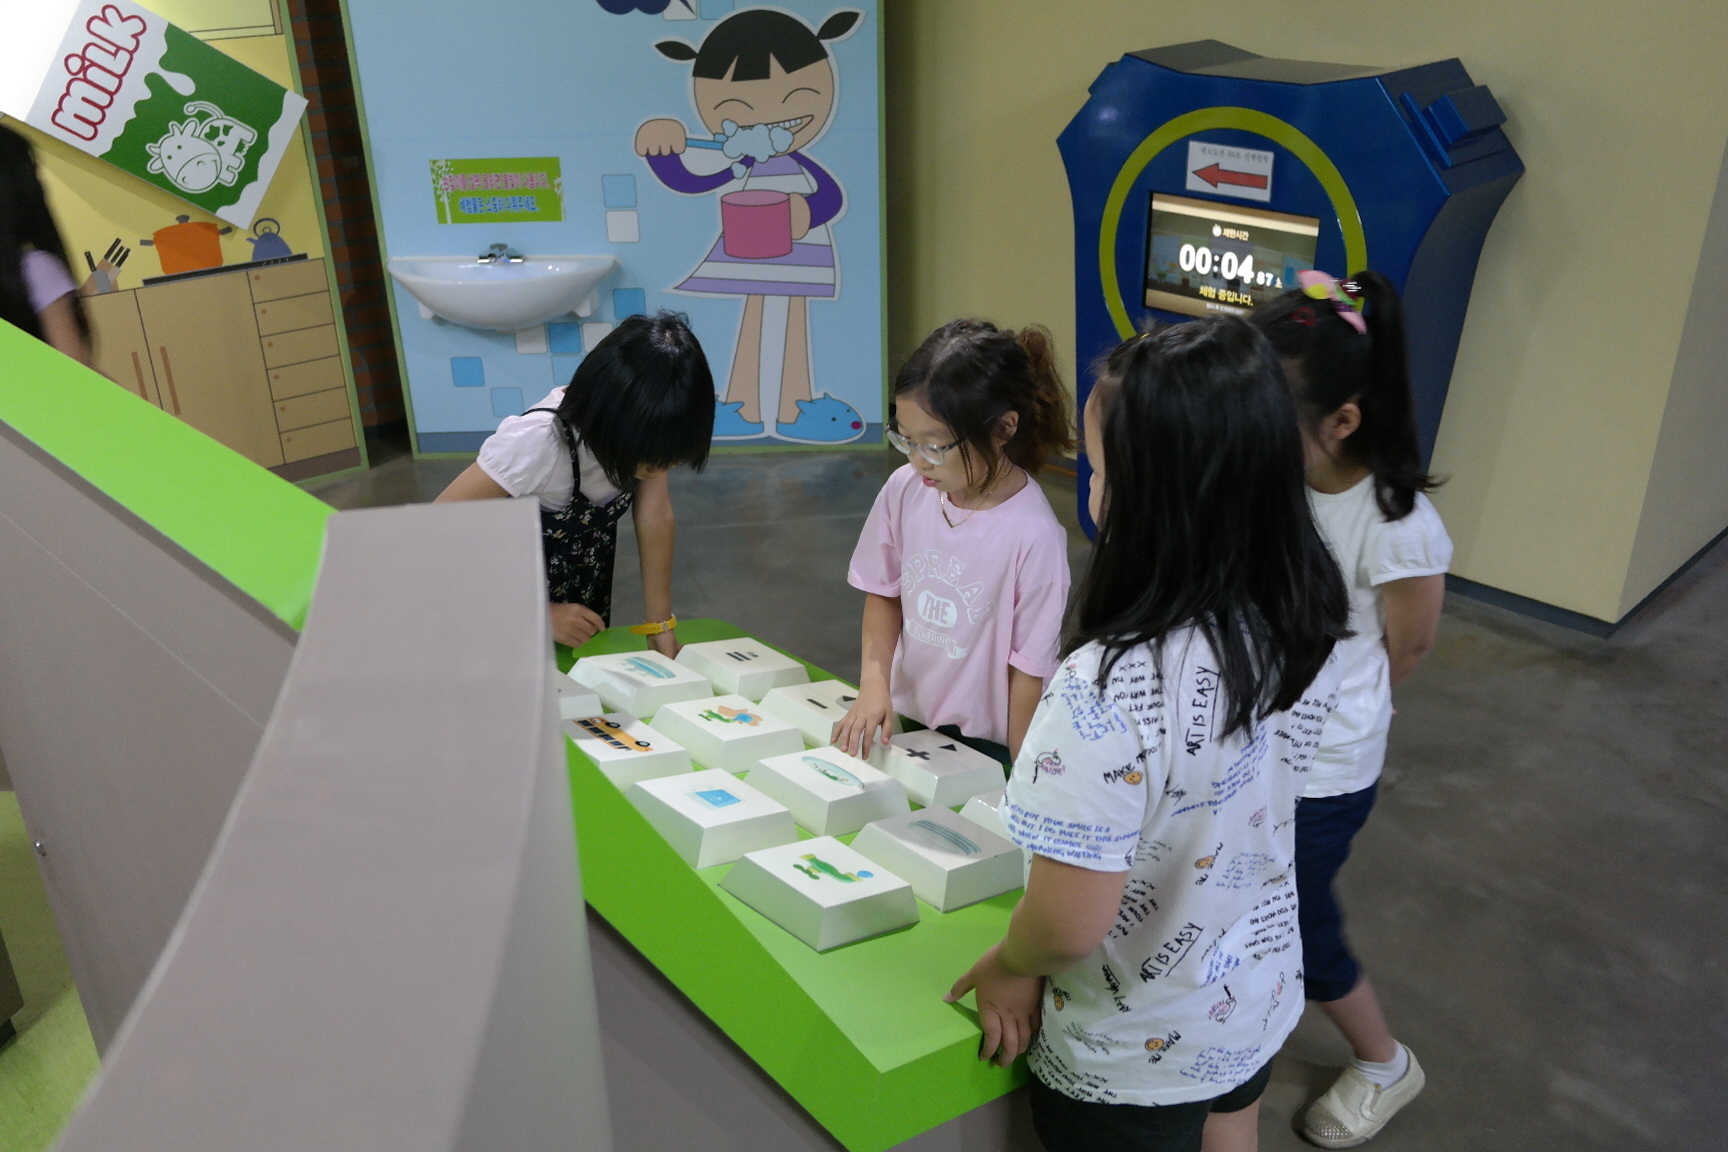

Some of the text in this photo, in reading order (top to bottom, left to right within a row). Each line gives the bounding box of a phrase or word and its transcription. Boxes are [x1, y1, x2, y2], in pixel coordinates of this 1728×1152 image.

[1222, 228, 1250, 241] 제한시간
[1179, 243, 1255, 285] 00:04
[1199, 285, 1254, 307] 체험 중입니다.
[921, 593, 951, 625] THE
[1130, 690, 1145, 698] WAY
[1186, 665, 1221, 757] ART IS EASY
[1103, 762, 1135, 784] MAKE
[1060, 829, 1080, 838] MISS
[1082, 832, 1092, 840] IT
[1067, 822, 1092, 832] SMILE
[1140, 922, 1204, 984] ART IS EASY
